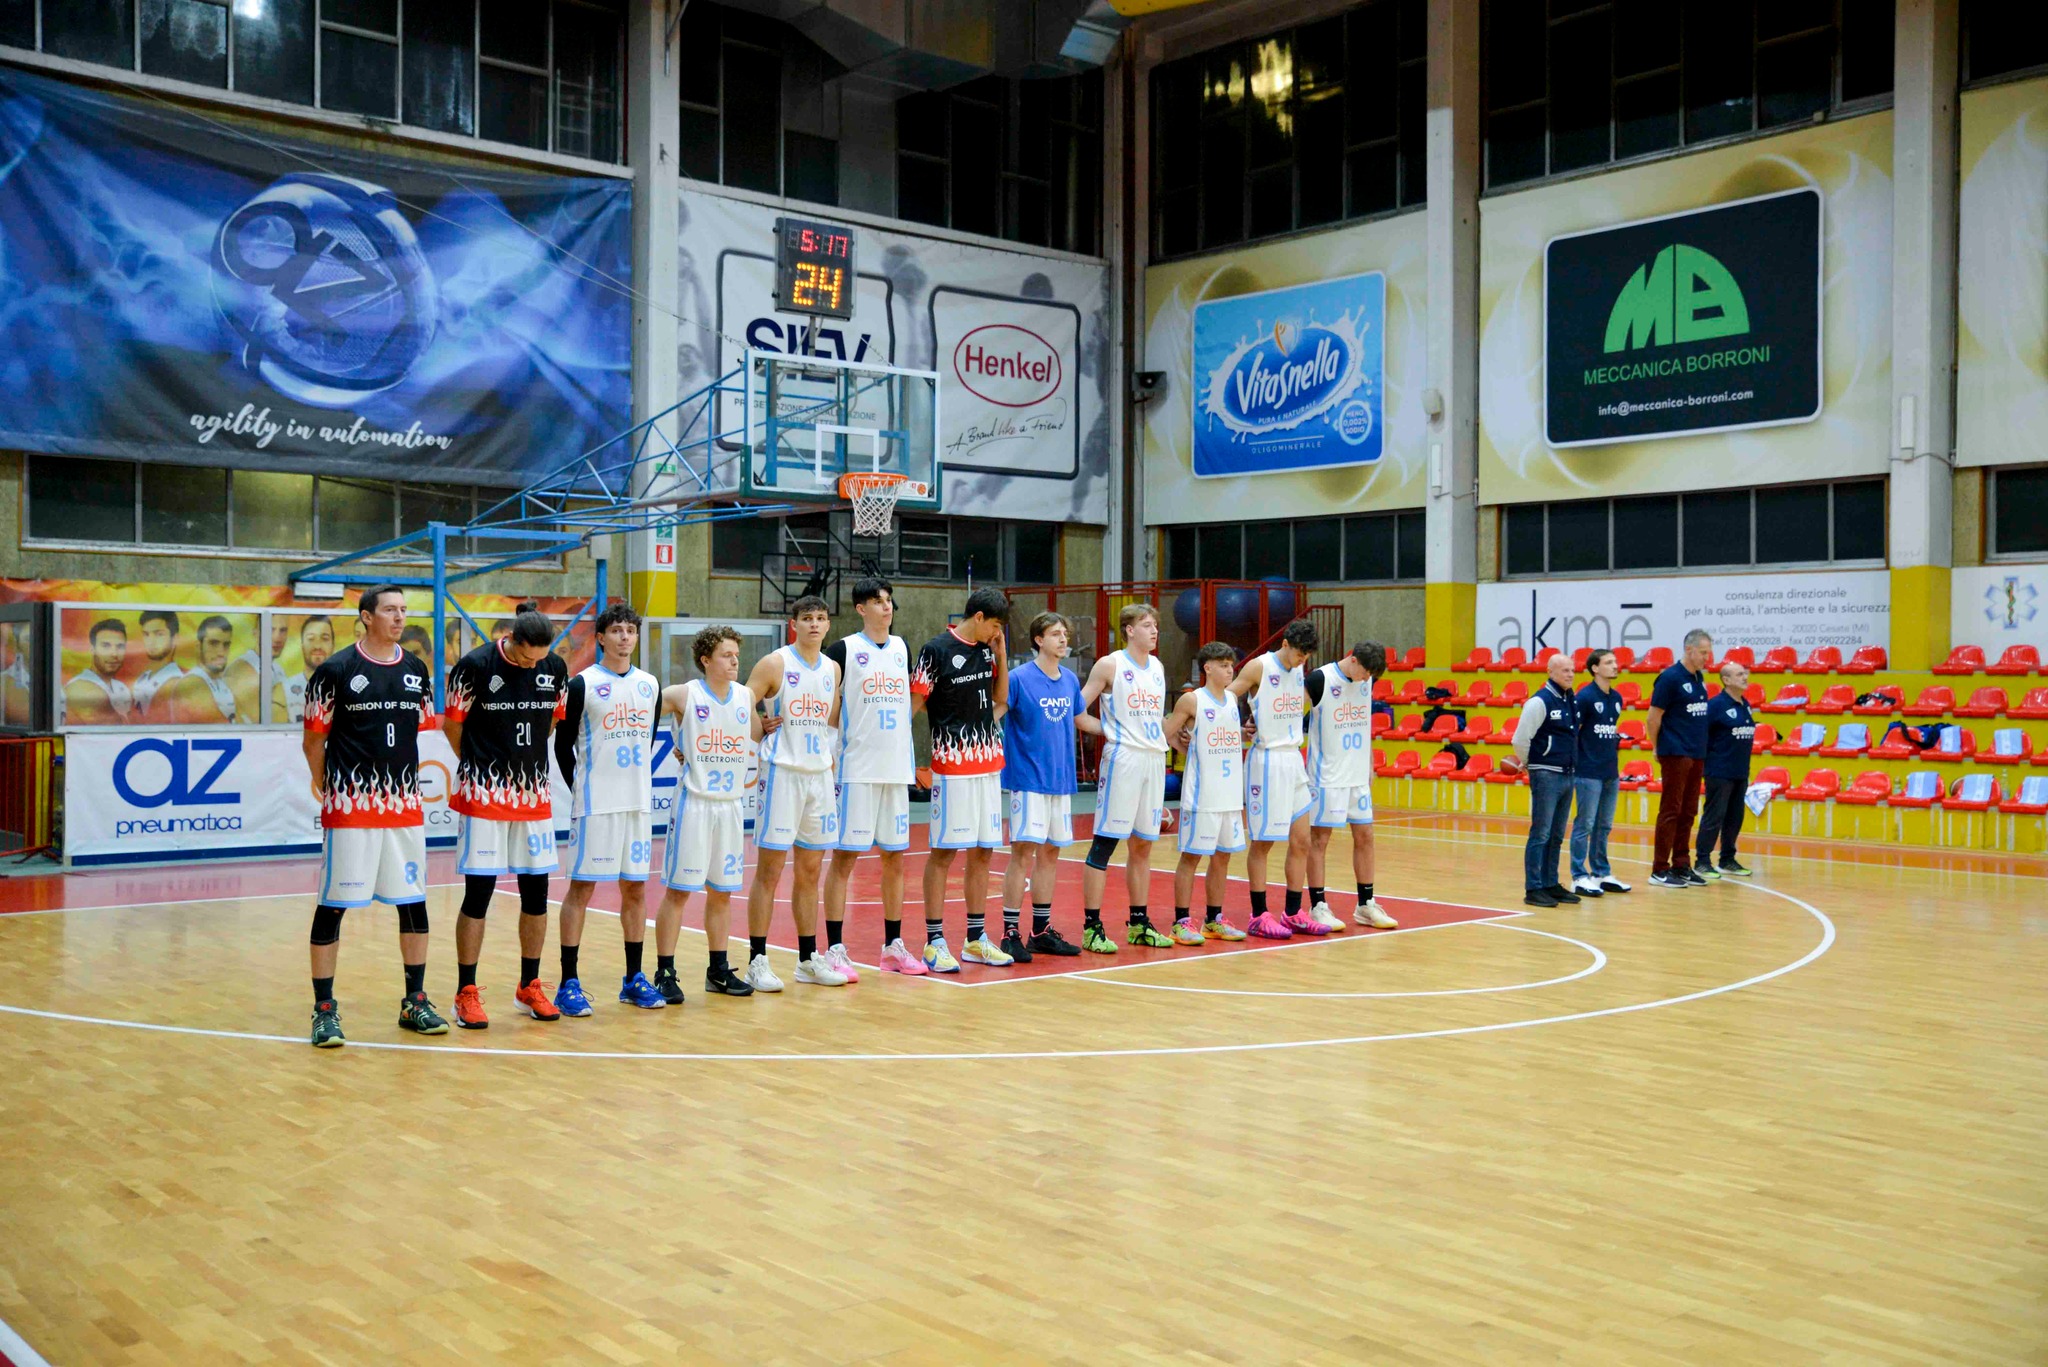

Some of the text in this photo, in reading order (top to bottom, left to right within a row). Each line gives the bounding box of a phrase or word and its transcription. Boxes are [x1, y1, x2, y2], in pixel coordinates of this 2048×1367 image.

[801, 229, 848, 257] 5:17
[793, 262, 843, 309] 24
[965, 344, 1052, 383] Henkel
[1584, 345, 1770, 385] MECCANICA BORRONI
[1236, 336, 1341, 415] VitaSnella
[1598, 390, 1754, 416] info@meccanica-borroni.com
[190, 402, 454, 450] agility in automation
[1251, 440, 1322, 455] OLIGOMINERALE
[1725, 587, 1848, 600] consulenza direzionale
[1684, 608, 1702, 619] per
[1704, 605, 1715, 615] la
[1757, 604, 1815, 615] l'ambiente
[1818, 606, 1826, 614] e
[1828, 603, 1839, 613] la
[1727, 637, 1738, 645] 02
[1740, 637, 1781, 645] 99020028
[1805, 636, 1815, 645] 02
[1818, 636, 1862, 645] 99022284
[951, 674, 977, 684] VISION
[345, 702, 382, 711] VISION
[384, 702, 396, 710] OF
[481, 702, 515, 711] VISION
[517, 702, 530, 710] OF
[978, 689, 988, 709] 14
[1039, 696, 1071, 708] CANTÙ
[877, 709, 897, 730] 15
[386, 722, 396, 747] 8
[516, 722, 531, 746] 20
[1343, 732, 1363, 751] 00
[112, 738, 242, 808] az
[1222, 759, 1231, 778] 5
[707, 770, 735, 792] 23
[116, 813, 241, 838] pneumatica
[820, 812, 837, 834] 16
[895, 814, 908, 835] 15
[1233, 820, 1239, 840] 5
[527, 831, 552, 857] 94
[630, 840, 650, 864] 88
[405, 861, 419, 885] 8
